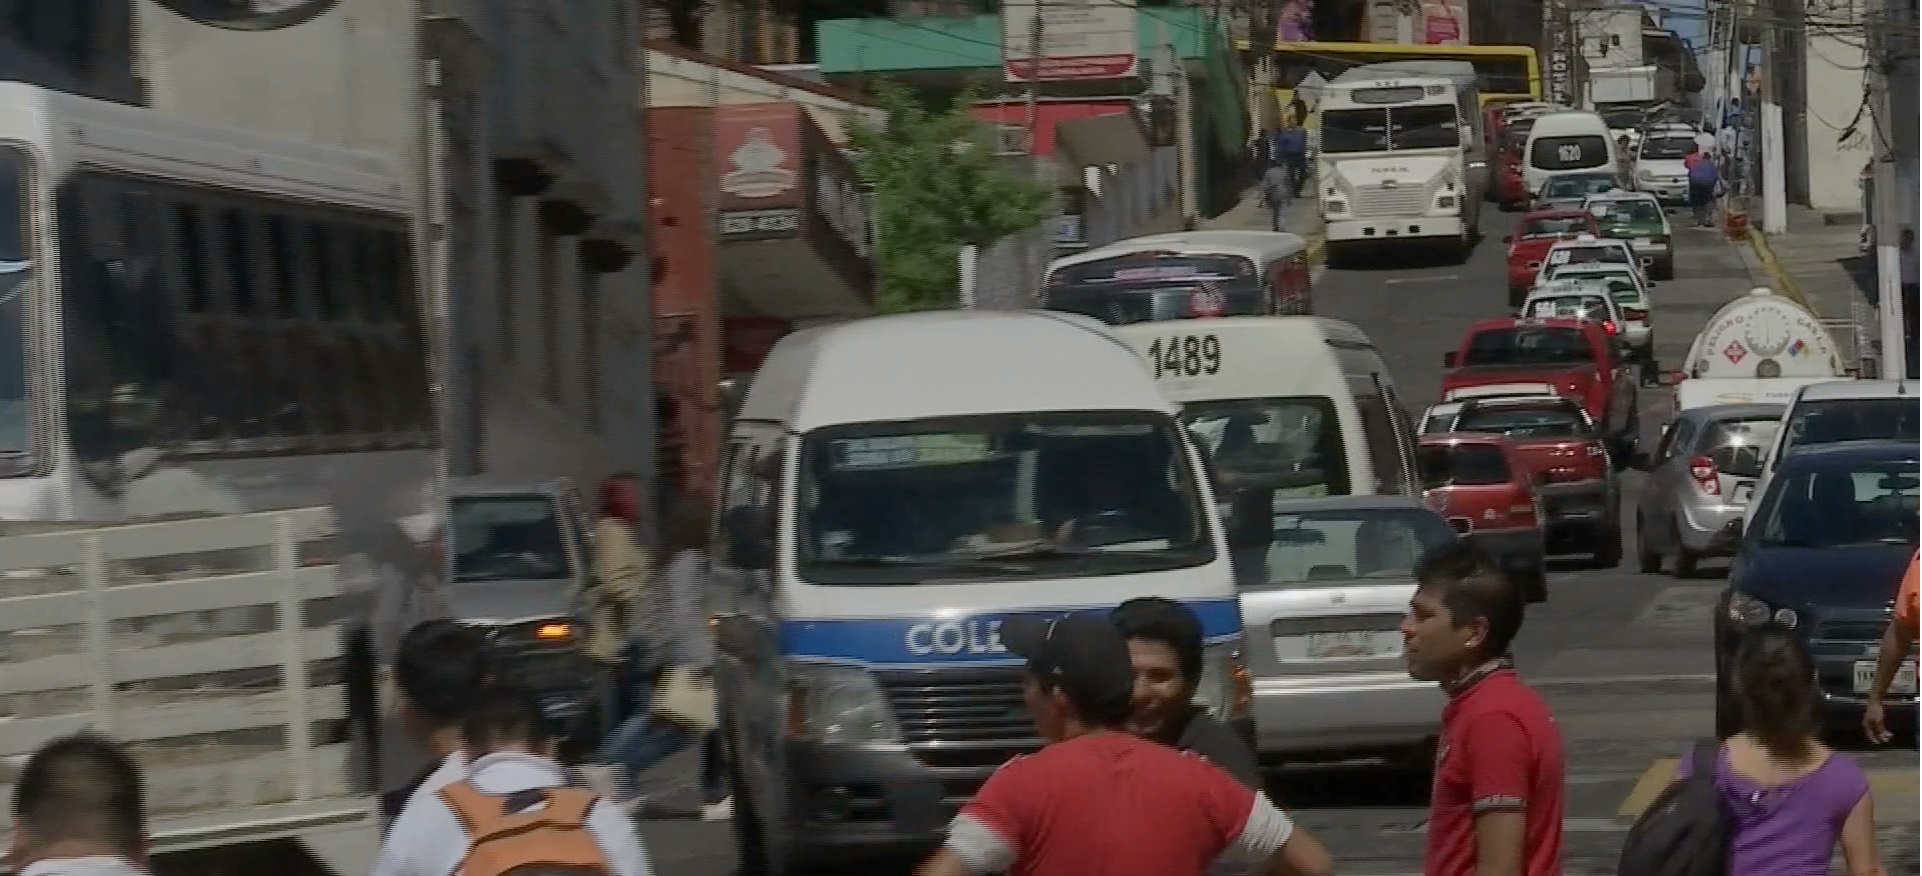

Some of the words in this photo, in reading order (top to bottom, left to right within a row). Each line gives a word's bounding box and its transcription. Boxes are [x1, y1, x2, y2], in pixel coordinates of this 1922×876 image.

[1558, 144, 1582, 162] 1620
[1707, 315, 1745, 356] PELIGRO
[1147, 334, 1222, 379] 1489
